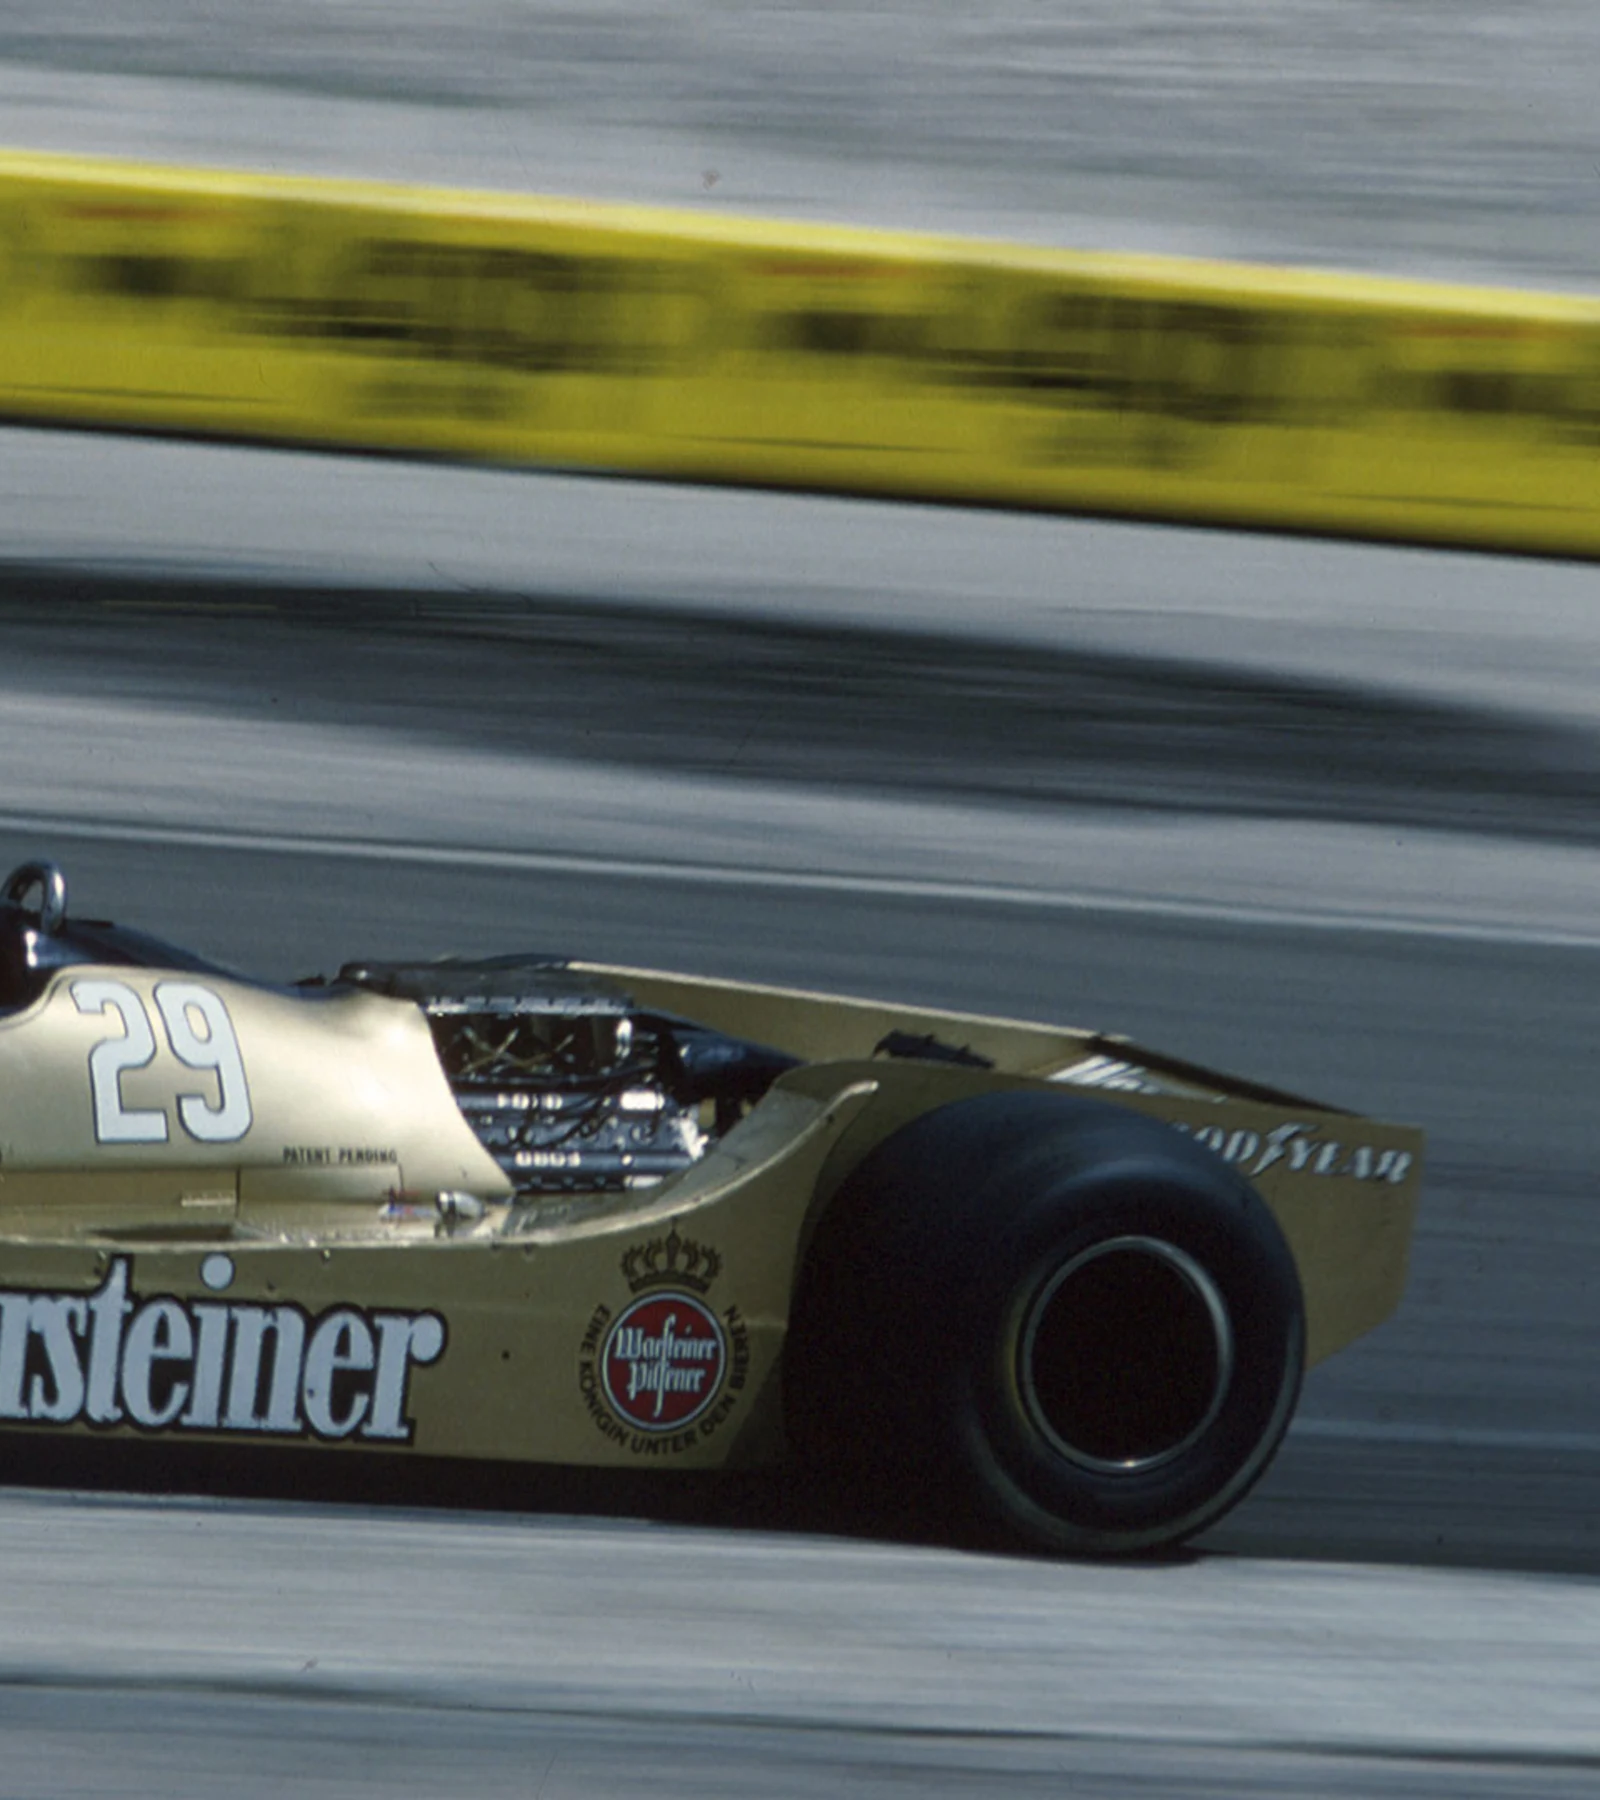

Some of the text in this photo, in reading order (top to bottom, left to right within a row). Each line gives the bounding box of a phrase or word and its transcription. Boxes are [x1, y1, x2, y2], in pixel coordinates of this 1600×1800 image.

[70, 979, 253, 1143] 29
[283, 1147, 397, 1163] PATENT PENDING
[580, 1304, 611, 1355] EINE
[614, 1313, 717, 1361] Warsteiner
[579, 1361, 629, 1447] KÖNIGIN
[700, 1394, 736, 1436] DEN
[630, 1430, 698, 1455] UNTER
